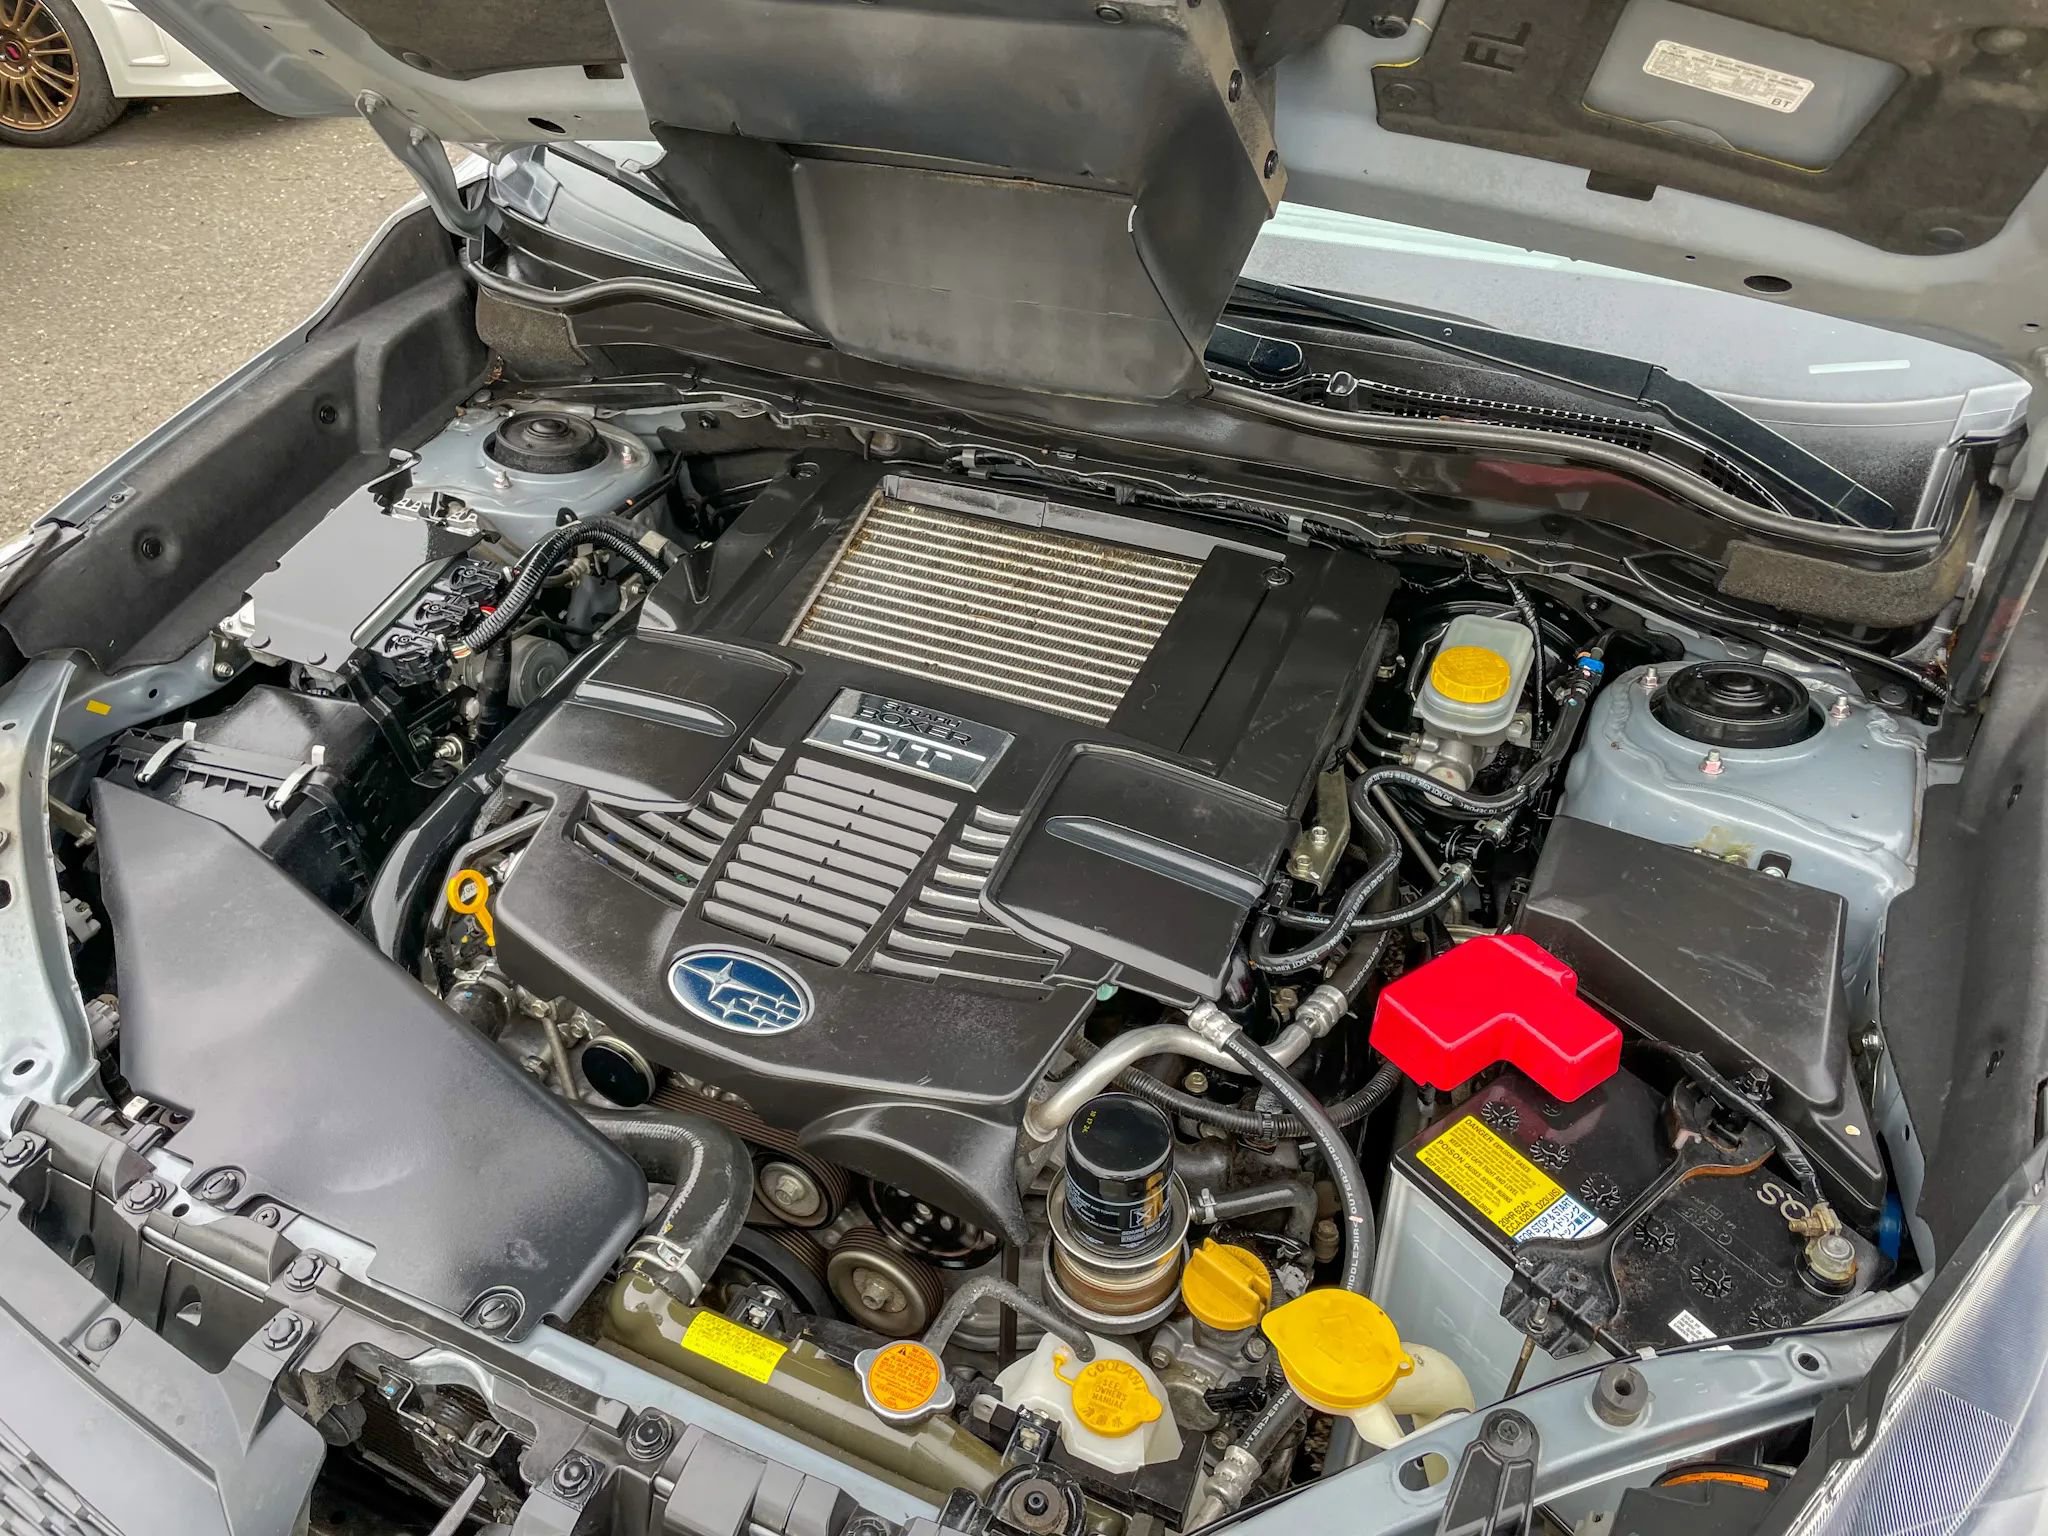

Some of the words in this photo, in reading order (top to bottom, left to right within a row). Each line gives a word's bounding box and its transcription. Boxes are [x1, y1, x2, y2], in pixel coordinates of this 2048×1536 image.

[1462, 21, 1533, 73] FL
[1771, 98, 1793, 109] BT
[857, 705, 973, 747] BOXER
[882, 701, 962, 729] SUBARU
[842, 727, 954, 769] DIT
[1464, 1118, 1493, 1143] DANGER
[1435, 1138, 1465, 1164] POISON
[1498, 1211, 1516, 1228] 20HR
[1515, 1200, 1532, 1215] 62Ah
[1505, 1219, 1522, 1234] CCA
[1520, 1208, 1537, 1223] 620A
[1530, 1217, 1550, 1234] STOP
[1547, 1213, 1555, 1221] &
[1551, 1198, 1574, 1217] START
[1087, 1361, 1147, 1392] COOLANT
